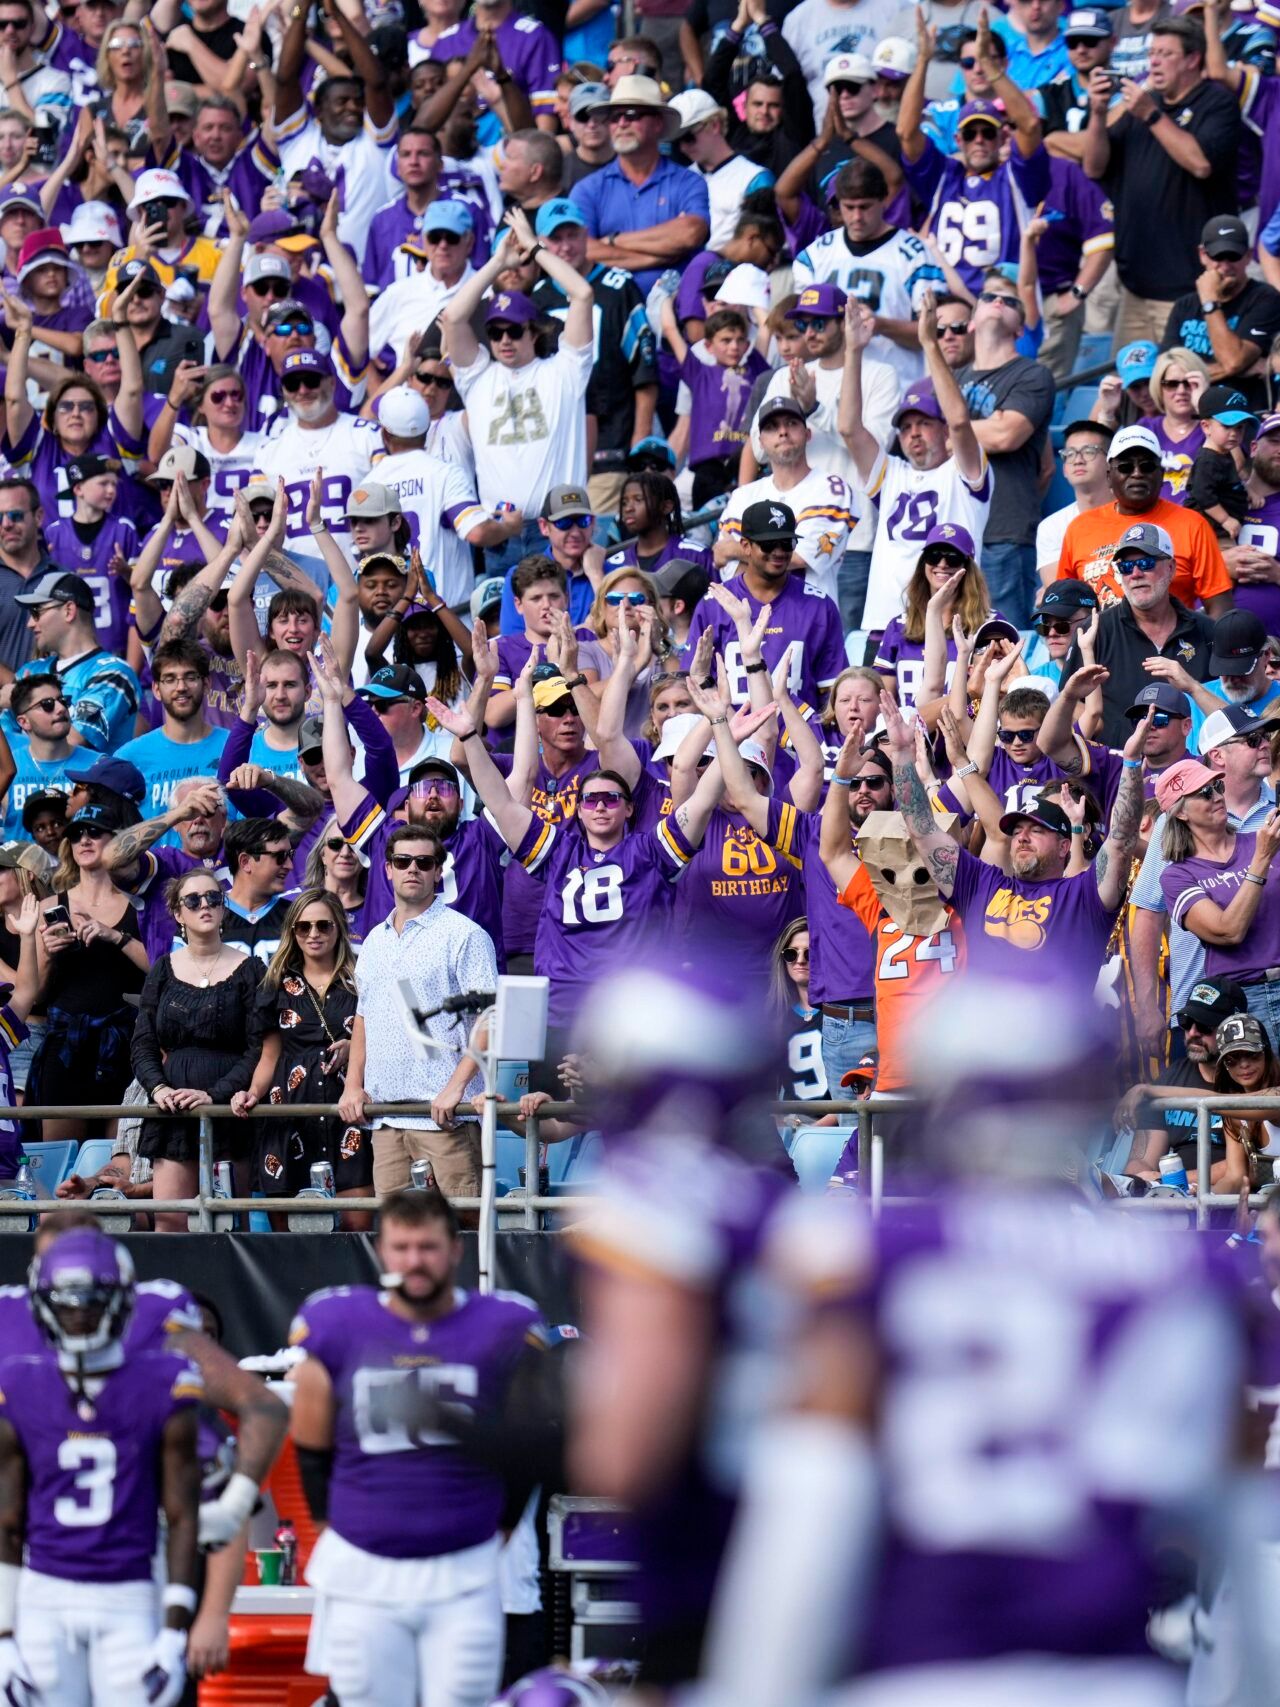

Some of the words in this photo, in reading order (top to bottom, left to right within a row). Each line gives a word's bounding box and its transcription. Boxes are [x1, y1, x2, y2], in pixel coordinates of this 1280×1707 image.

[947, 200, 1000, 267] 69
[711, 877, 789, 897] BIRTHDAY
[722, 838, 776, 877] 60
[561, 864, 624, 925] 18
[879, 922, 957, 980] 24
[788, 1029, 829, 1100] 9
[54, 1437, 117, 1528] 3
